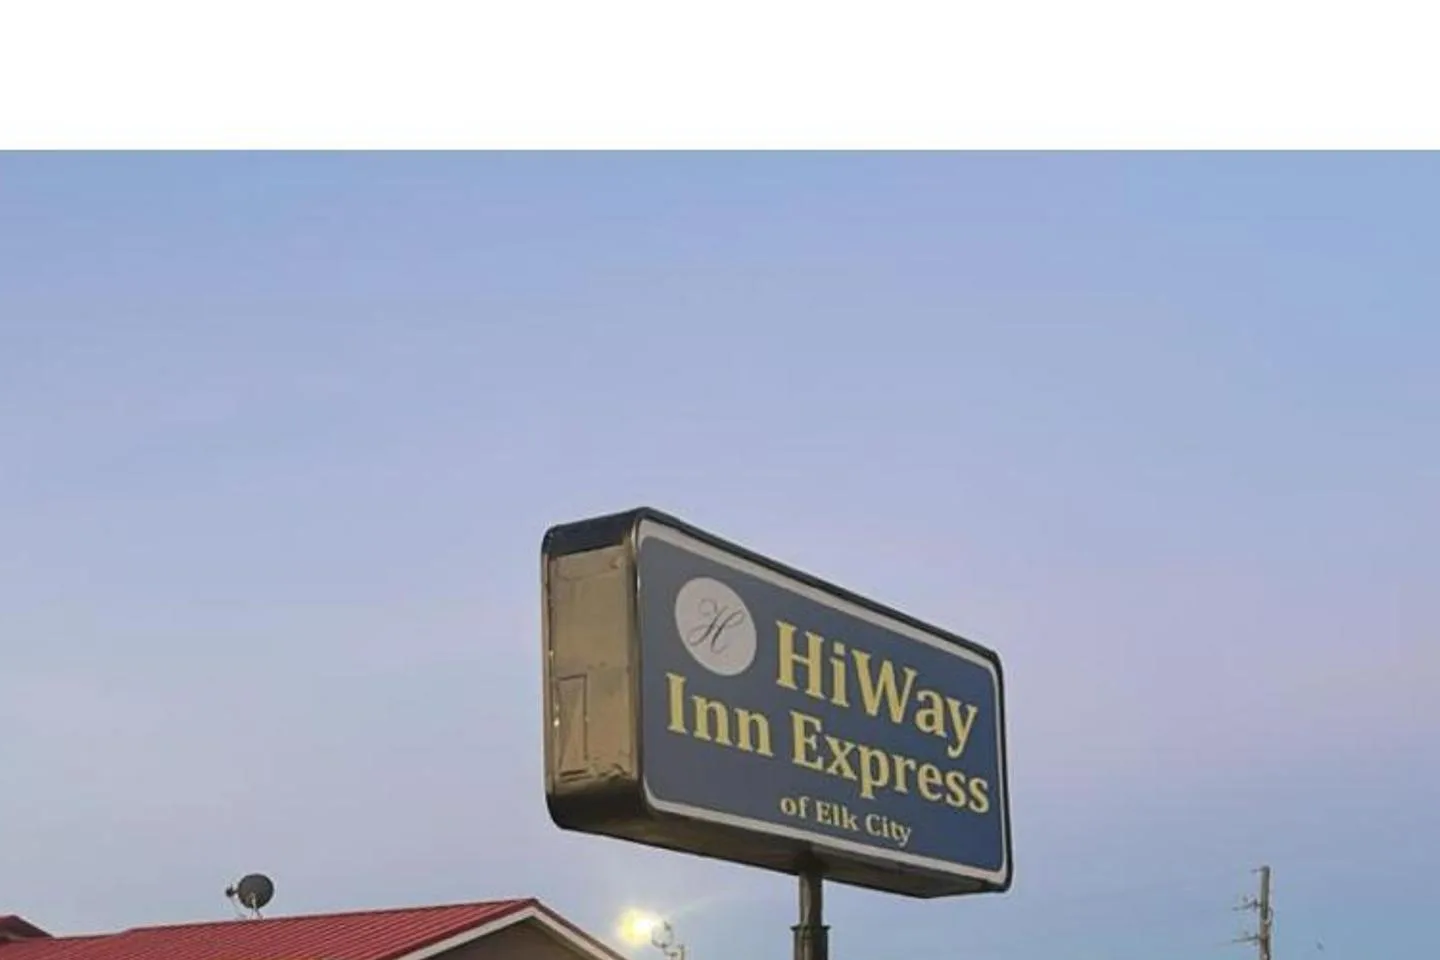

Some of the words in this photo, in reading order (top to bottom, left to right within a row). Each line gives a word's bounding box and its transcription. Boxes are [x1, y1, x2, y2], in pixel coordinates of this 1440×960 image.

[667, 673, 773, 758] Inn
[790, 711, 990, 814] Express
[776, 621, 977, 757] HiWay
[780, 797, 810, 819] of
[815, 800, 859, 831] Elk
[865, 814, 912, 847] City
